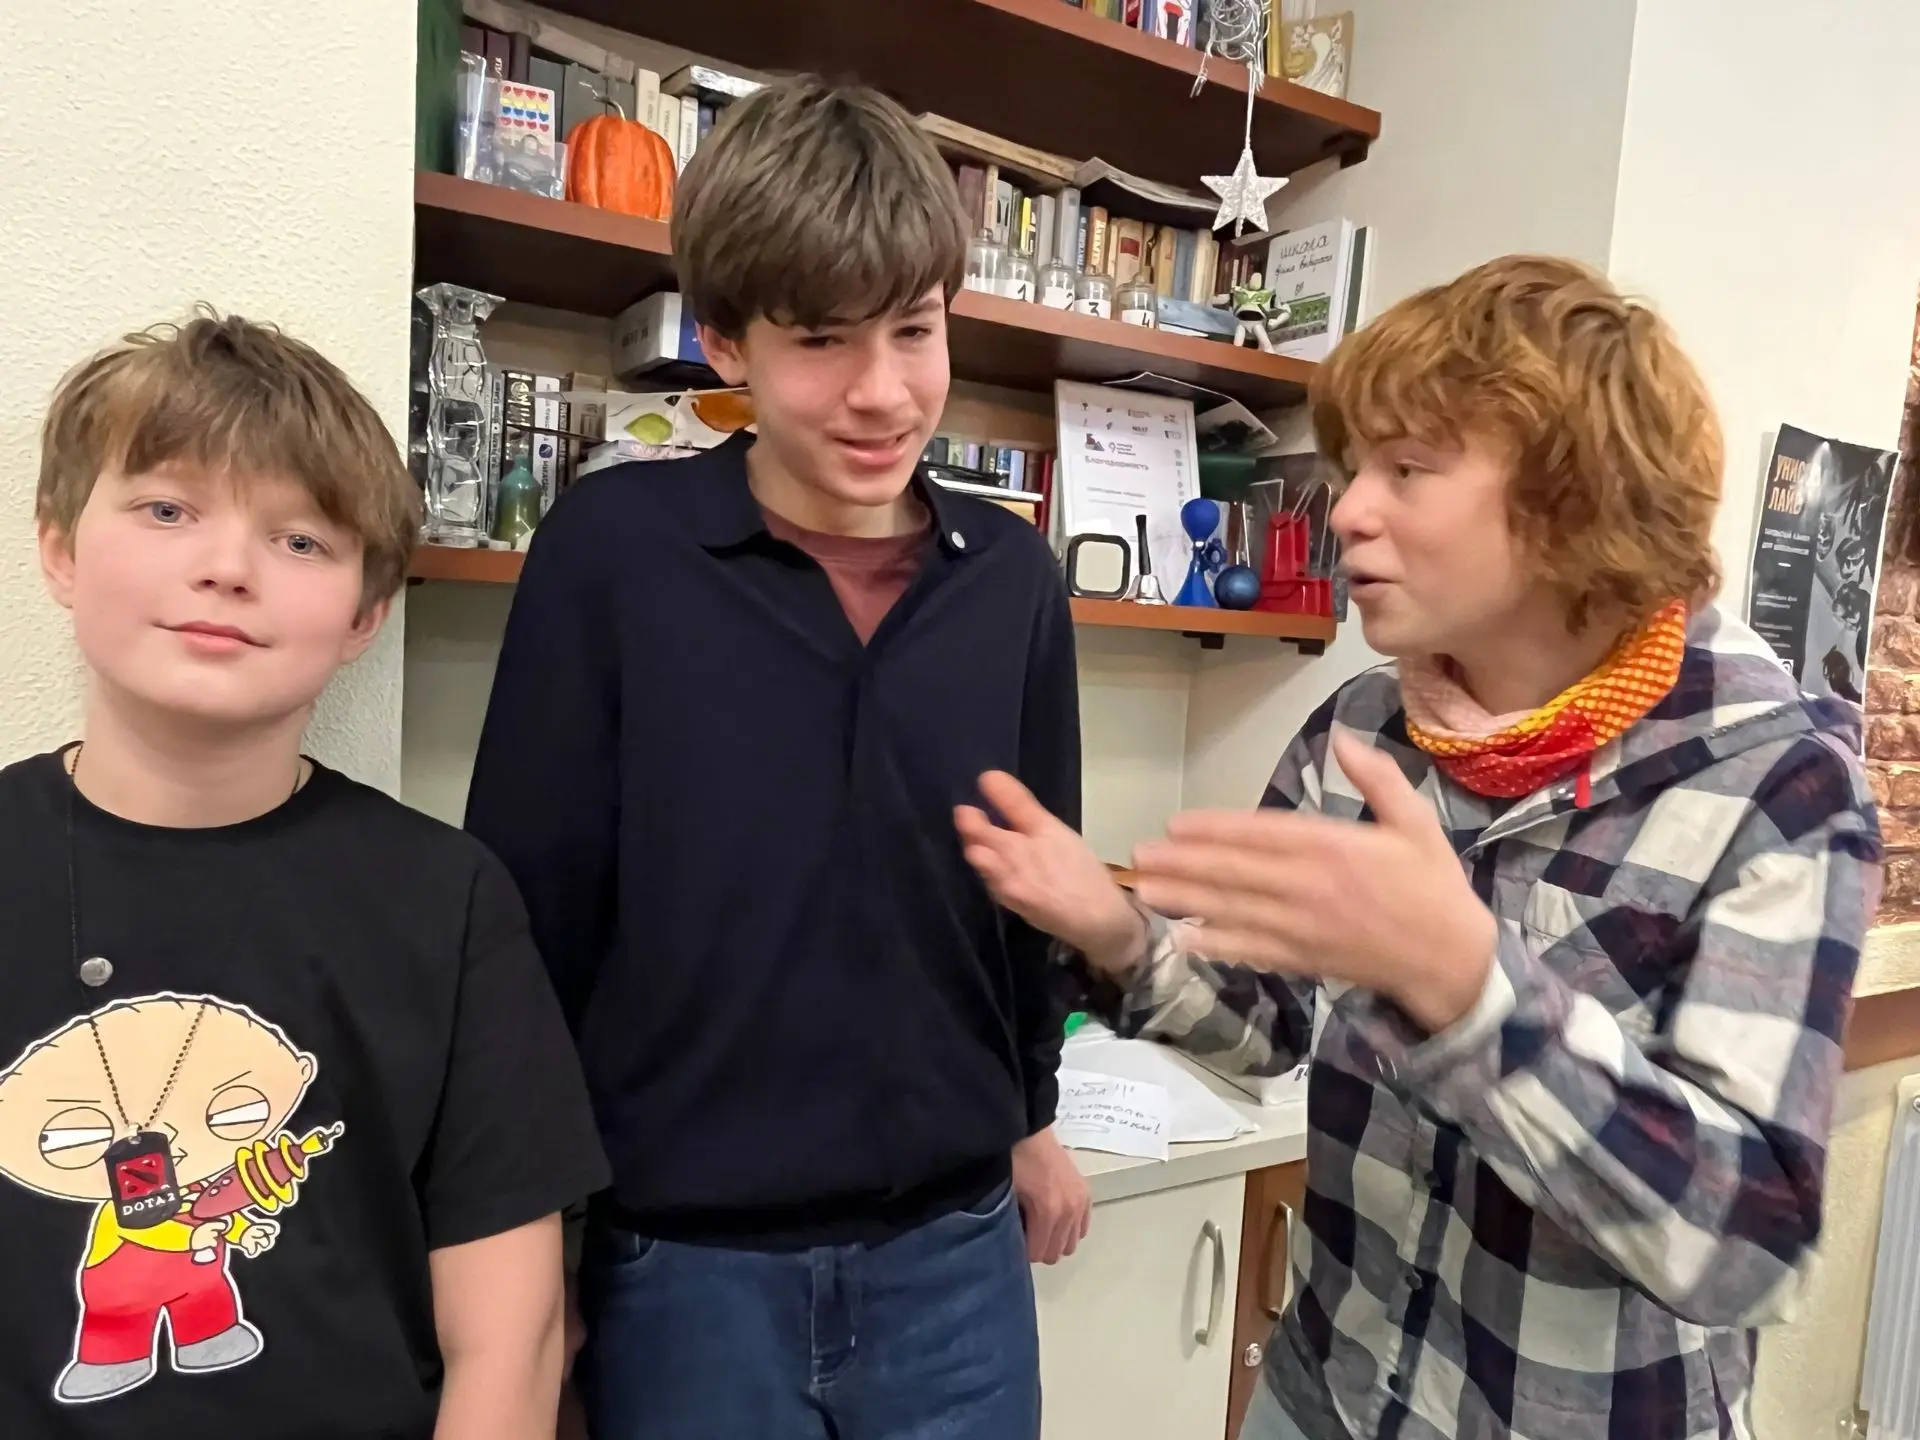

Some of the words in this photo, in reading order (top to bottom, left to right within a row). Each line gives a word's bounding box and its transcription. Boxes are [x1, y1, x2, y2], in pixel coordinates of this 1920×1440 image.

[1017, 284, 1027, 301] 1
[1088, 301, 1100, 317] 3
[1142, 312, 1151, 327] 4
[122, 1197, 166, 1215] DOTA
[167, 1192, 176, 1202] 2
